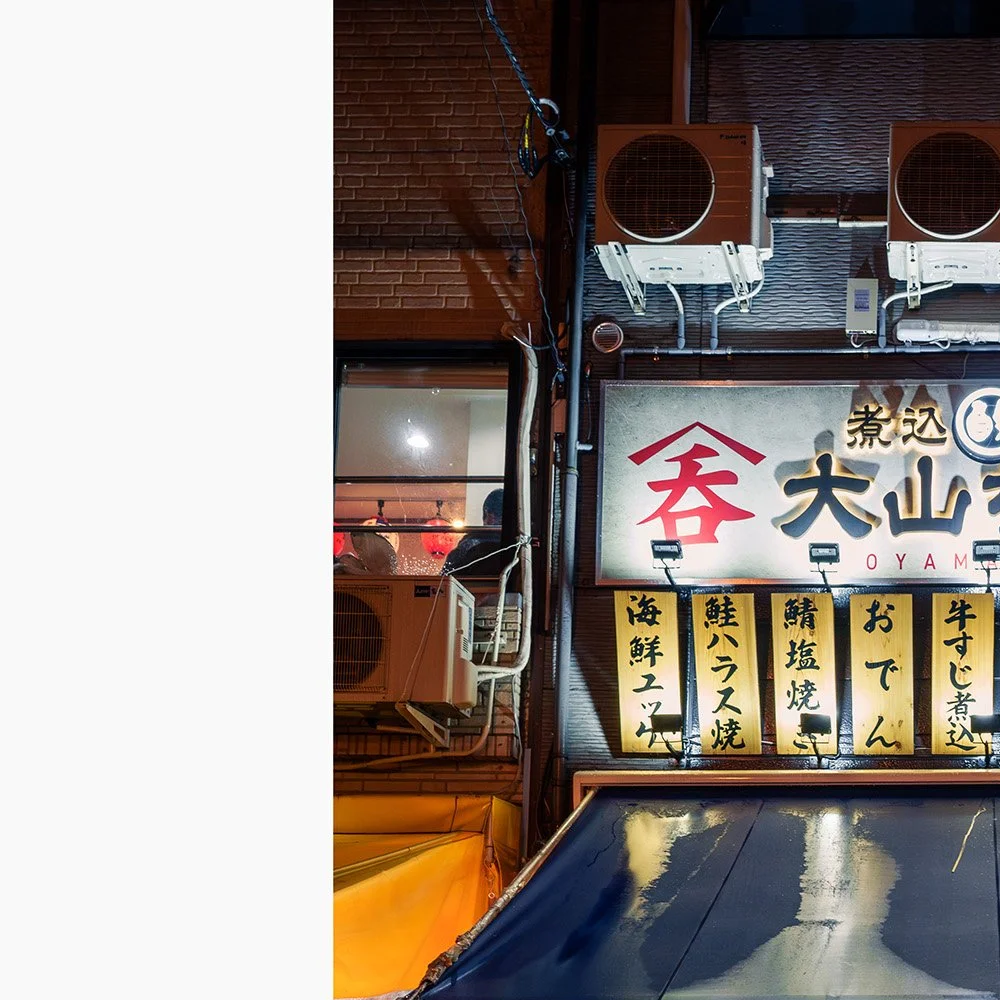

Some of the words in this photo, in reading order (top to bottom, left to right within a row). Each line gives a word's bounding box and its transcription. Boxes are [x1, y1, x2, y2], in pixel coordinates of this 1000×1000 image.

[847, 405, 948, 448] 煮込
[703, 595, 746, 750] 鮭ハラス焼
[863, 599, 900, 748] おでん
[943, 600, 977, 751] 牛すじ煮込
